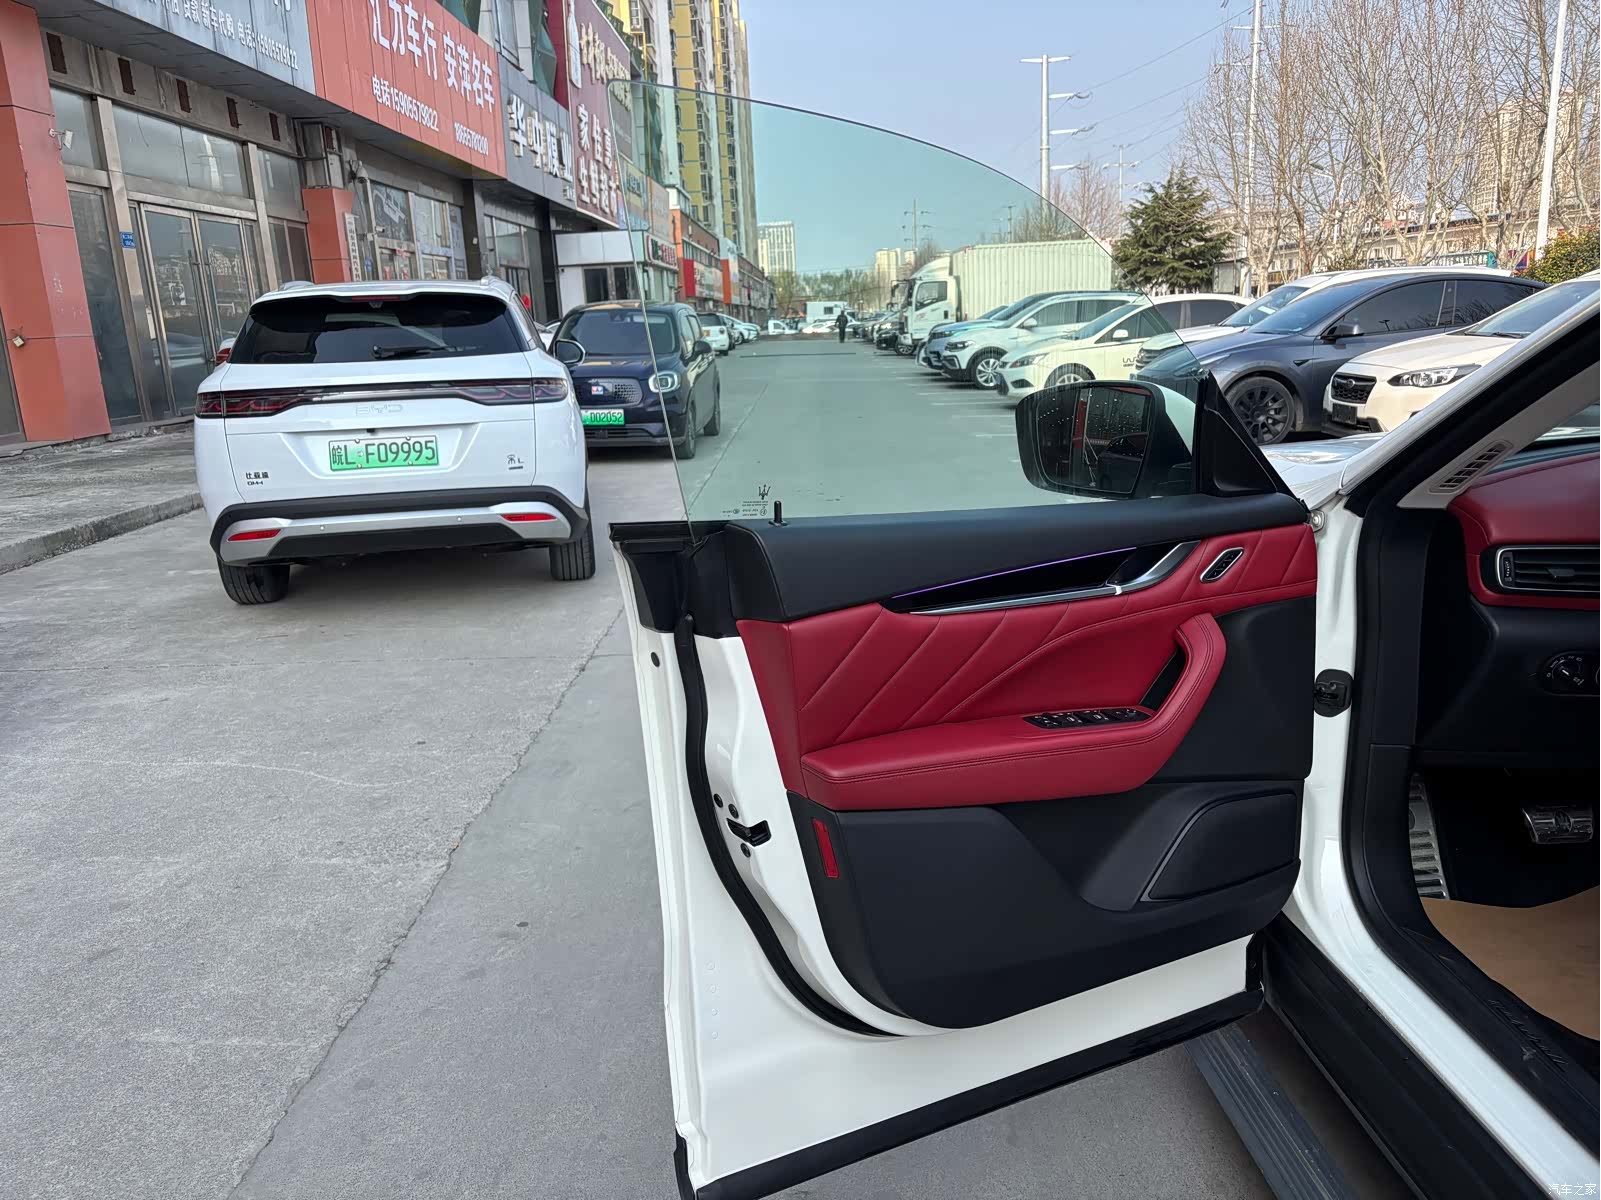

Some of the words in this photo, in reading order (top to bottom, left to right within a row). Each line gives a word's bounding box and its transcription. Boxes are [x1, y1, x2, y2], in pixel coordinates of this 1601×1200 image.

[369, 0, 438, 81] 汇力车行
[442, 30, 495, 113] 安萍名车
[356, 403, 404, 416] BYD
